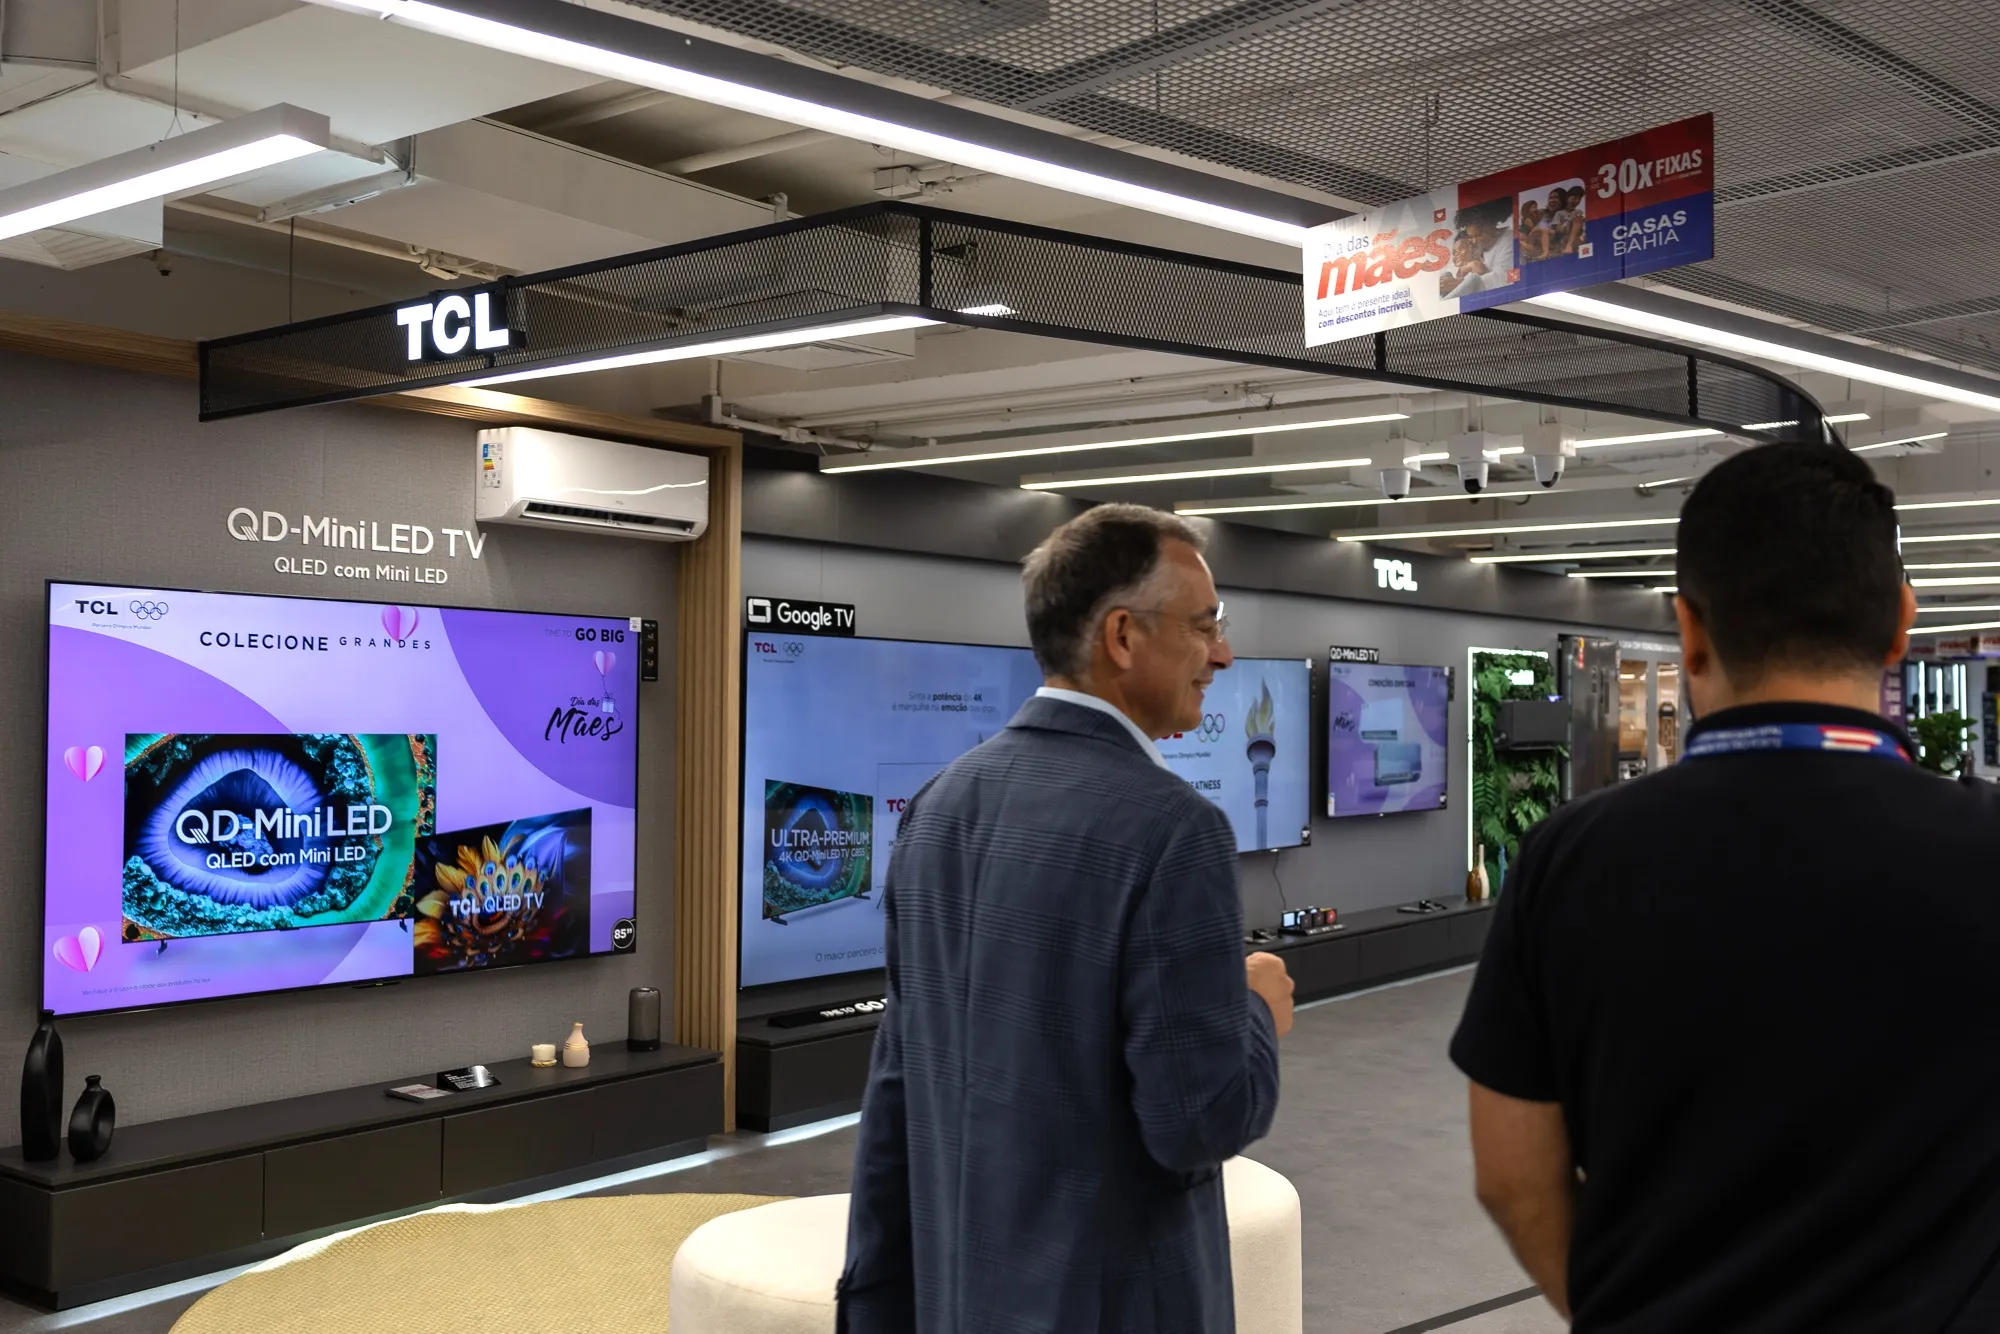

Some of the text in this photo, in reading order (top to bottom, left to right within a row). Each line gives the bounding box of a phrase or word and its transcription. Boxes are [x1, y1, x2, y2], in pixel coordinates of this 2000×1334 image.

[1655, 148, 1702, 178] FIXAS
[1612, 210, 1687, 240] CASAS
[1346, 235, 1369, 252] das
[1613, 228, 1680, 257] BAHIA
[1316, 227, 1453, 300] mães
[1318, 299, 1413, 329] com descontos incríveis
[1335, 304, 1350, 314] tem
[1357, 294, 1391, 309] presente
[1391, 287, 1411, 301] ideal
[396, 292, 509, 361] TCL
[441, 528, 487, 559] TV
[274, 556, 448, 584] QLED com Mini LED
[1373, 558, 1418, 591] TCL
[75, 599, 118, 615] TCL
[777, 602, 854, 631] Google TV
[200, 631, 431, 651] COLECIONE GRANDES
[575, 627, 597, 641] GO
[600, 629, 625, 643] BIG
[754, 642, 778, 654] TCL
[544, 706, 624, 744] Mães
[771, 828, 870, 848] ULTRA-PREMIUM
[206, 845, 367, 870] QLED com Mini LED
[779, 851, 792, 863] 4K
[841, 848, 850, 858] TV
[450, 891, 545, 917] TCL QLED TV
[824, 951, 845, 961] maior
[846, 947, 877, 959] parceiro
